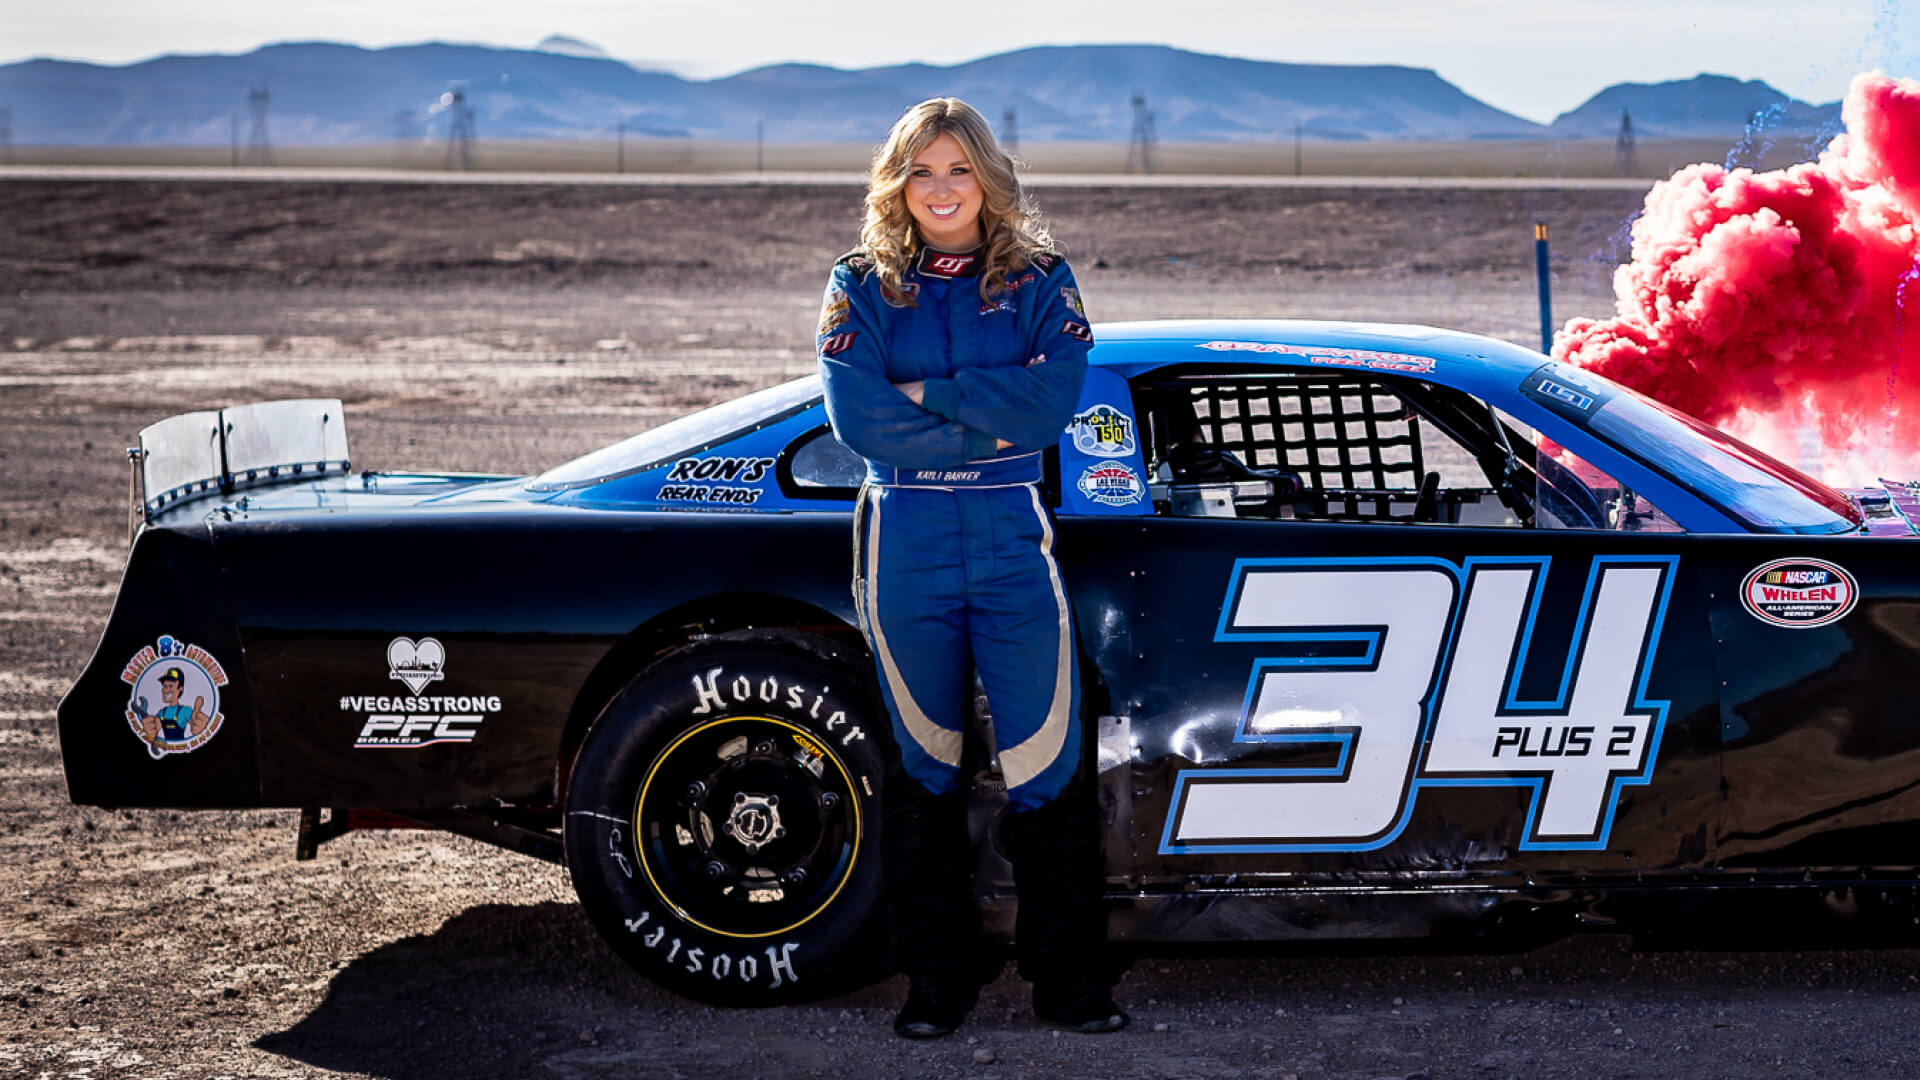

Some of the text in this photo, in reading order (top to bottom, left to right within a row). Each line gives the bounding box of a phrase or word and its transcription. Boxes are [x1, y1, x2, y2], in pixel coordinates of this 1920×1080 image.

[1094, 425, 1126, 444] 150
[666, 457, 776, 482] RON'S
[944, 470, 981, 481] BARKER
[656, 485, 763, 505] REAR ENDS
[1786, 571, 1829, 583] NASCAR
[1763, 586, 1837, 601] WHELEN
[340, 696, 502, 712] #VEGASSTRONG
[692, 666, 865, 746] Hoosier
[1158, 555, 1680, 854] 34
[360, 715, 484, 737] PFC
[356, 736, 421, 744] BRAKES
[1492, 726, 1636, 757] PLUS 2
[625, 911, 800, 989] Hoosier
